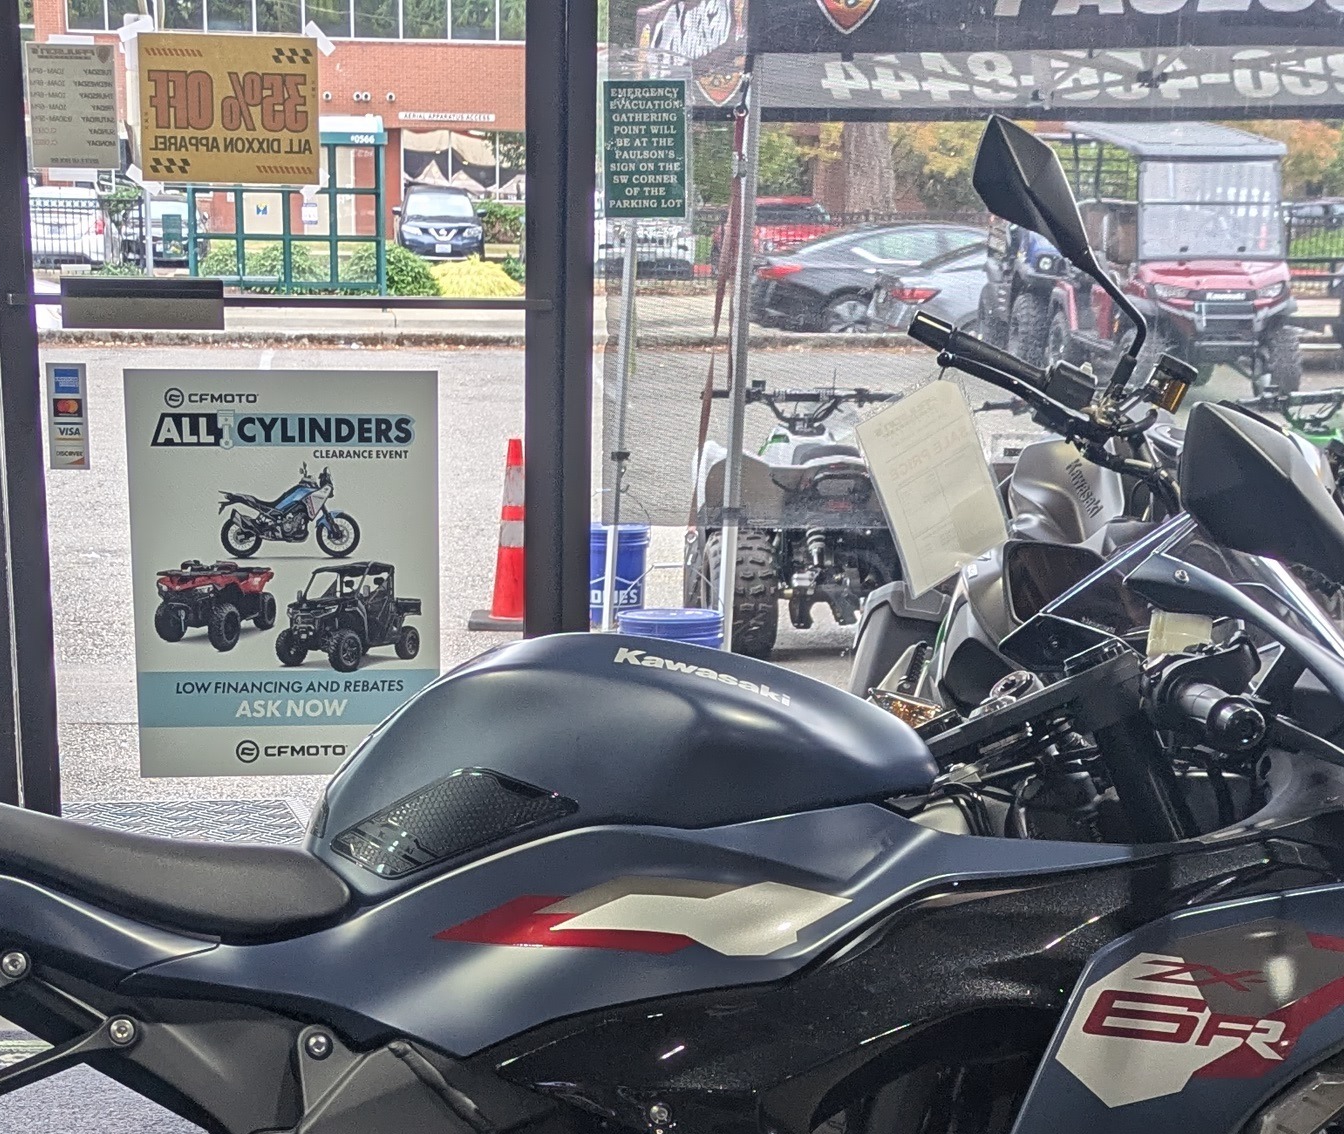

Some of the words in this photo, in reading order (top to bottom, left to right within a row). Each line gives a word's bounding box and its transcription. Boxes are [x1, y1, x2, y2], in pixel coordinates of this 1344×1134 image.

[610, 88, 679, 97] EMERGENCY
[609, 100, 680, 109] EVACUATION
[612, 113, 677, 122] GATHERING
[613, 126, 647, 134] POINT
[650, 126, 677, 134] WILL
[616, 138, 631, 147] BE
[634, 138, 649, 146] AT
[652, 138, 675, 146] THE
[615, 150, 675, 159] PAULSON'S
[610, 163, 636, 172] SIGN
[639, 163, 654, 172] ON
[658, 162, 681, 171] THE
[613, 175, 629, 184] SW
[632, 175, 678, 184] CORNER
[625, 187, 640, 196] OF
[643, 187, 666, 196] THE
[609, 200, 657, 209] PARKING
[661, 199, 683, 208] LOT
[188, 393, 257, 404] CFMOTO
[58, 427, 81, 436] VISA
[157, 417, 215, 443] ALL
[236, 416, 413, 444] CYLINDERS
[313, 450, 374, 459] CLEARANCE
[375, 450, 409, 459] EVENT
[613, 647, 791, 707] Kawasaki
[176, 682, 212, 694] LOW
[214, 681, 303, 694] FINANCING
[306, 681, 341, 693] AND
[343, 679, 404, 692] REBATES
[235, 700, 281, 718] ASK
[286, 699, 348, 717] NOW
[264, 744, 346, 757] CFMOTO
